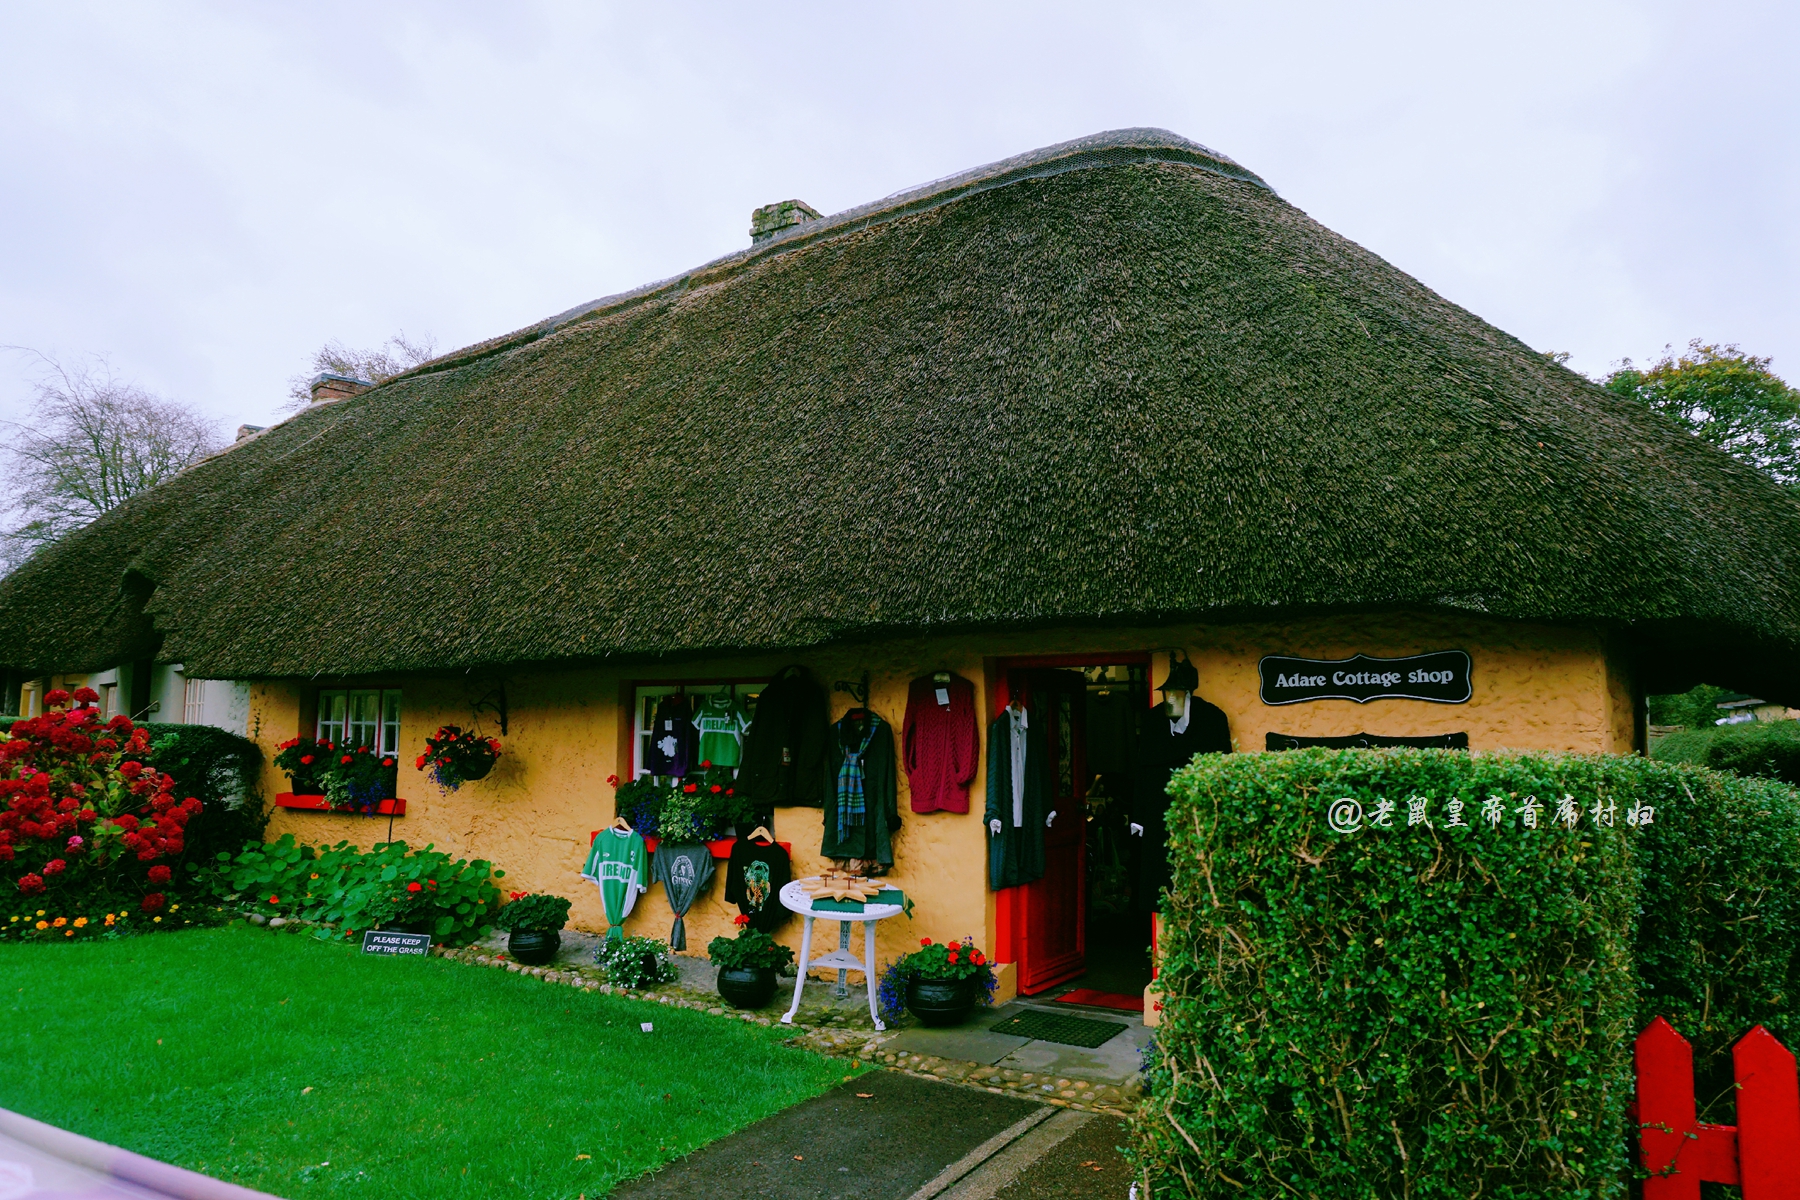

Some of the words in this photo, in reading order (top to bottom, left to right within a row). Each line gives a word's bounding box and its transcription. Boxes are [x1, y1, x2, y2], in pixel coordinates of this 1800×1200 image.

[1275, 672, 1326, 688] Adare
[1332, 670, 1401, 687] Cottage
[1408, 668, 1454, 685] shop
[373, 936, 400, 944] PLEASE
